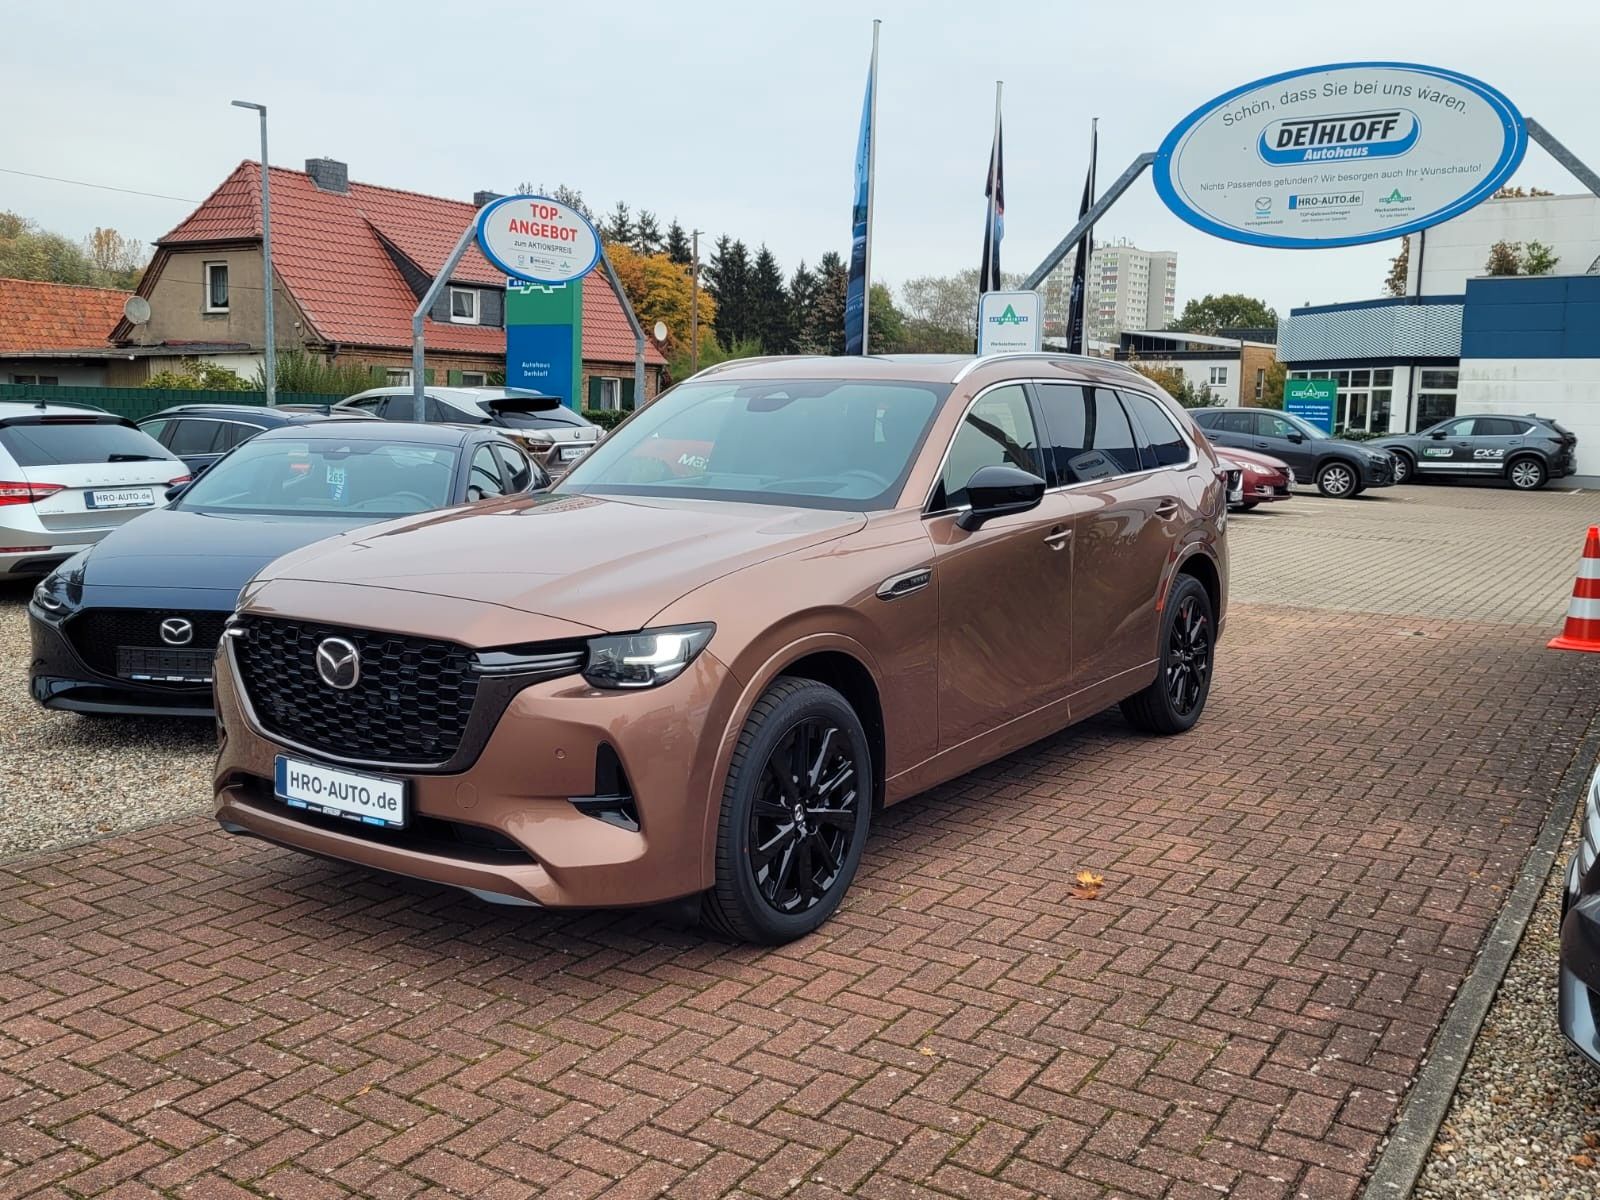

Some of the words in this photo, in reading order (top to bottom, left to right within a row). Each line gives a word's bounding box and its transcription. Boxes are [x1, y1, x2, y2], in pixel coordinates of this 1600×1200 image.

[1222, 100, 1275, 126] Schön,
[1280, 91, 1317, 105] dass
[1323, 82, 1348, 97] Sie
[1353, 80, 1378, 95] bei
[1383, 83, 1412, 97] uns
[1418, 87, 1466, 114] waren.
[1277, 112, 1400, 148] DETHLOFF
[1304, 146, 1369, 161] Autohaus
[1200, 183, 1225, 191] Nichts
[1227, 179, 1272, 189] Passendes
[1274, 175, 1319, 188] gefunden?
[1320, 174, 1336, 183] Wir
[1338, 172, 1379, 182] besorgen
[1381, 169, 1403, 179] auch
[1406, 168, 1418, 177] Ihr
[1421, 163, 1482, 176] Wunschauto!
[1298, 194, 1361, 206] HRO-AUTO.de
[508, 218, 577, 242] ANGEBOT
[528, 241, 573, 254] AKTIONSPREIS
[522, 361, 551, 369] Autohaus
[1473, 448, 1505, 457] CX-5
[328, 472, 344, 483] 265
[96, 493, 150, 502] HRO-AUTO.de
[290, 770, 397, 811] HRO-AUTO.de
